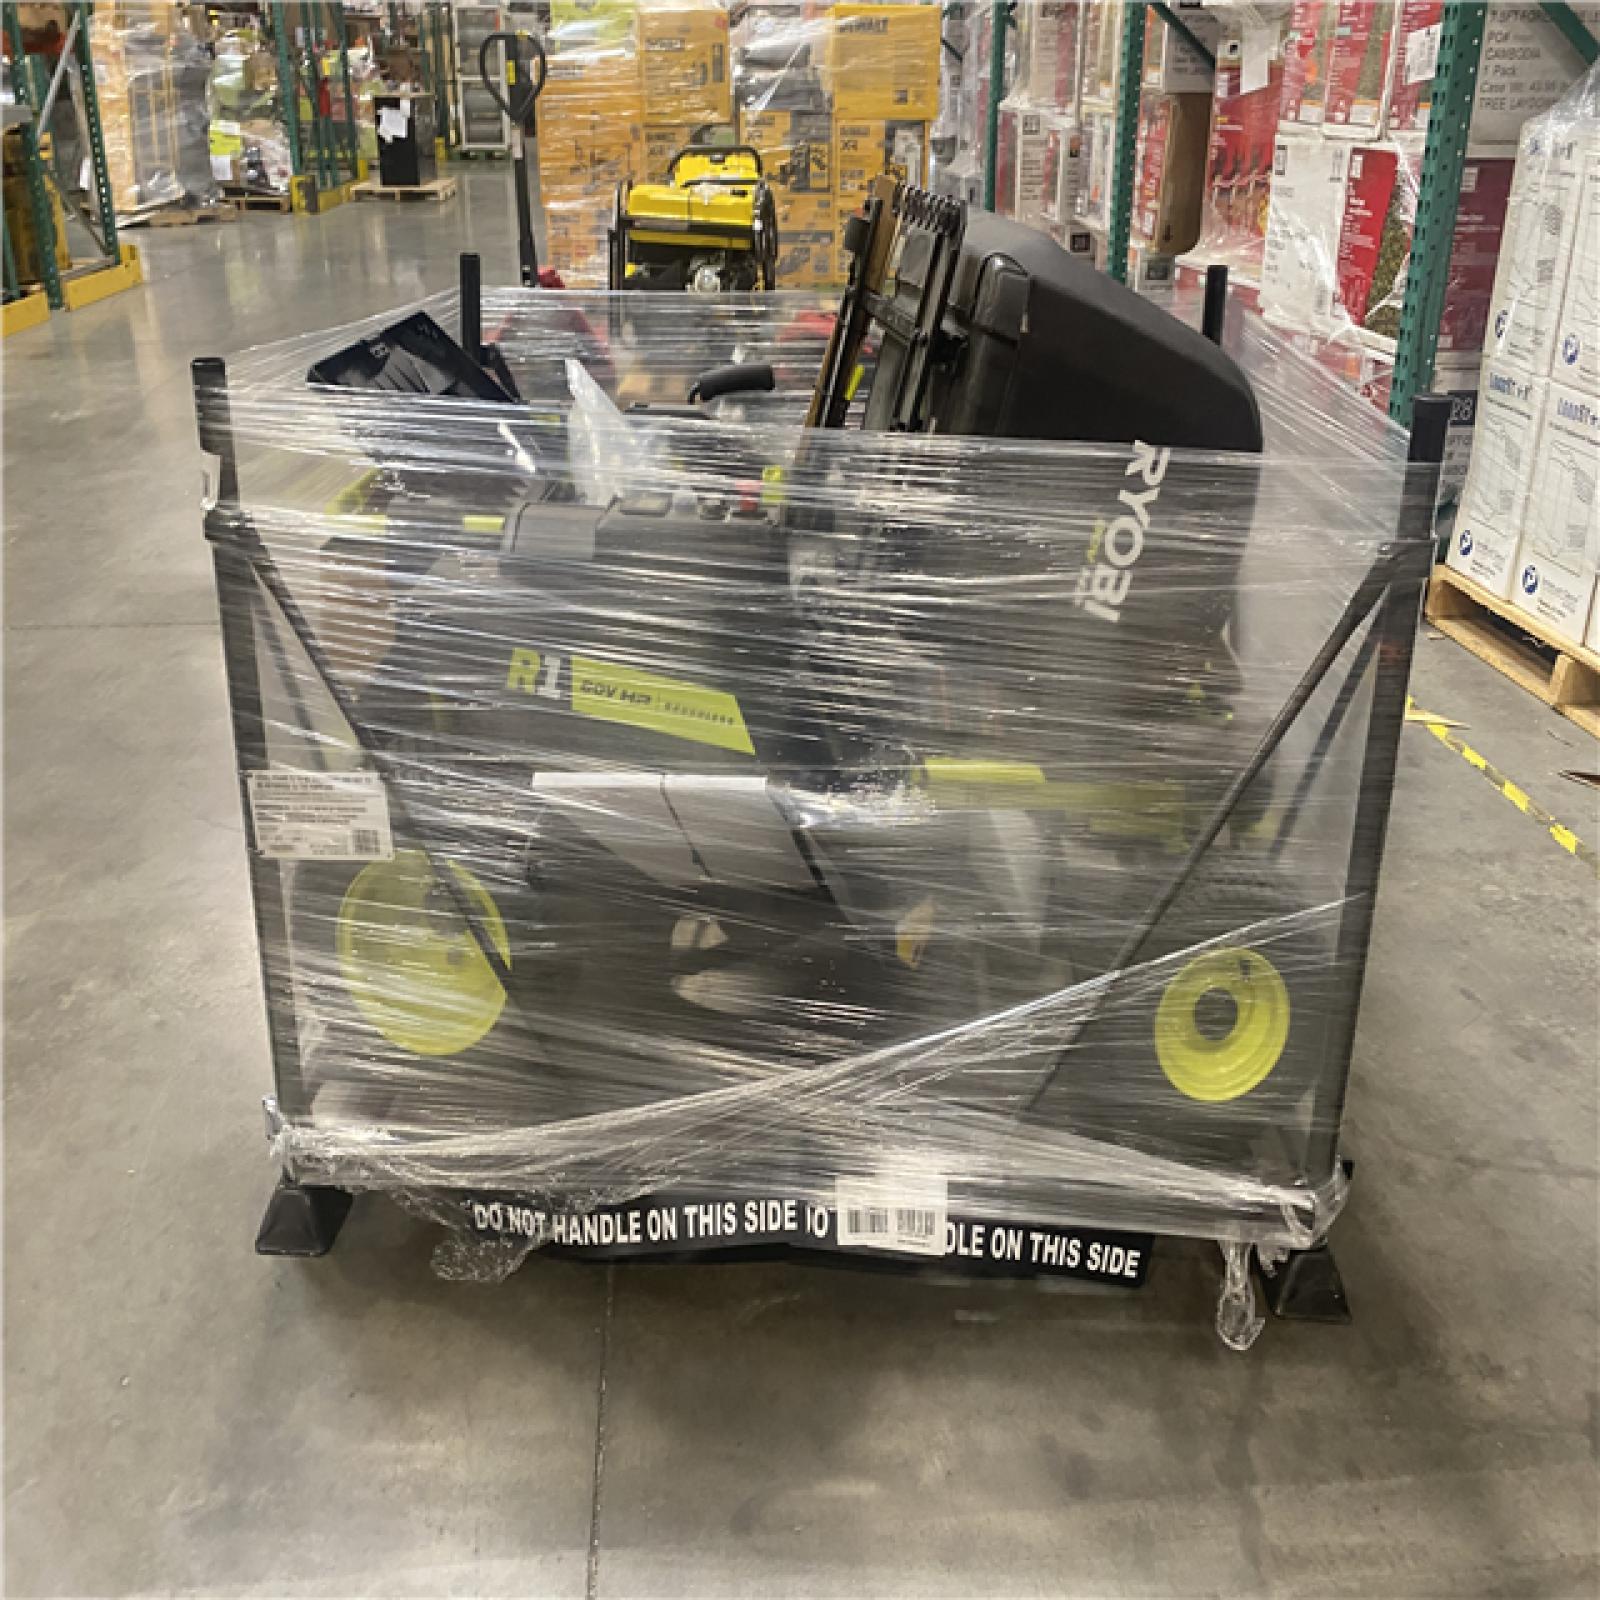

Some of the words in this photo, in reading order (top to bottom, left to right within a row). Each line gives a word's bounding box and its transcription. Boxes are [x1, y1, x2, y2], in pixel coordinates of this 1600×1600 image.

[1084, 440, 1171, 623] RYOBI
[507, 648, 561, 699] R1
[474, 1203, 501, 1231] DO
[508, 1205, 546, 1237] NOT
[551, 1210, 641, 1245] HANDLE
[648, 1207, 676, 1241] ON
[683, 1202, 736, 1237] THIS
[744, 1199, 797, 1232] SIDE
[945, 1221, 986, 1258] DLE
[991, 1227, 1022, 1261] ON
[1030, 1231, 1081, 1268] THIS
[1086, 1242, 1140, 1278] SIDE
